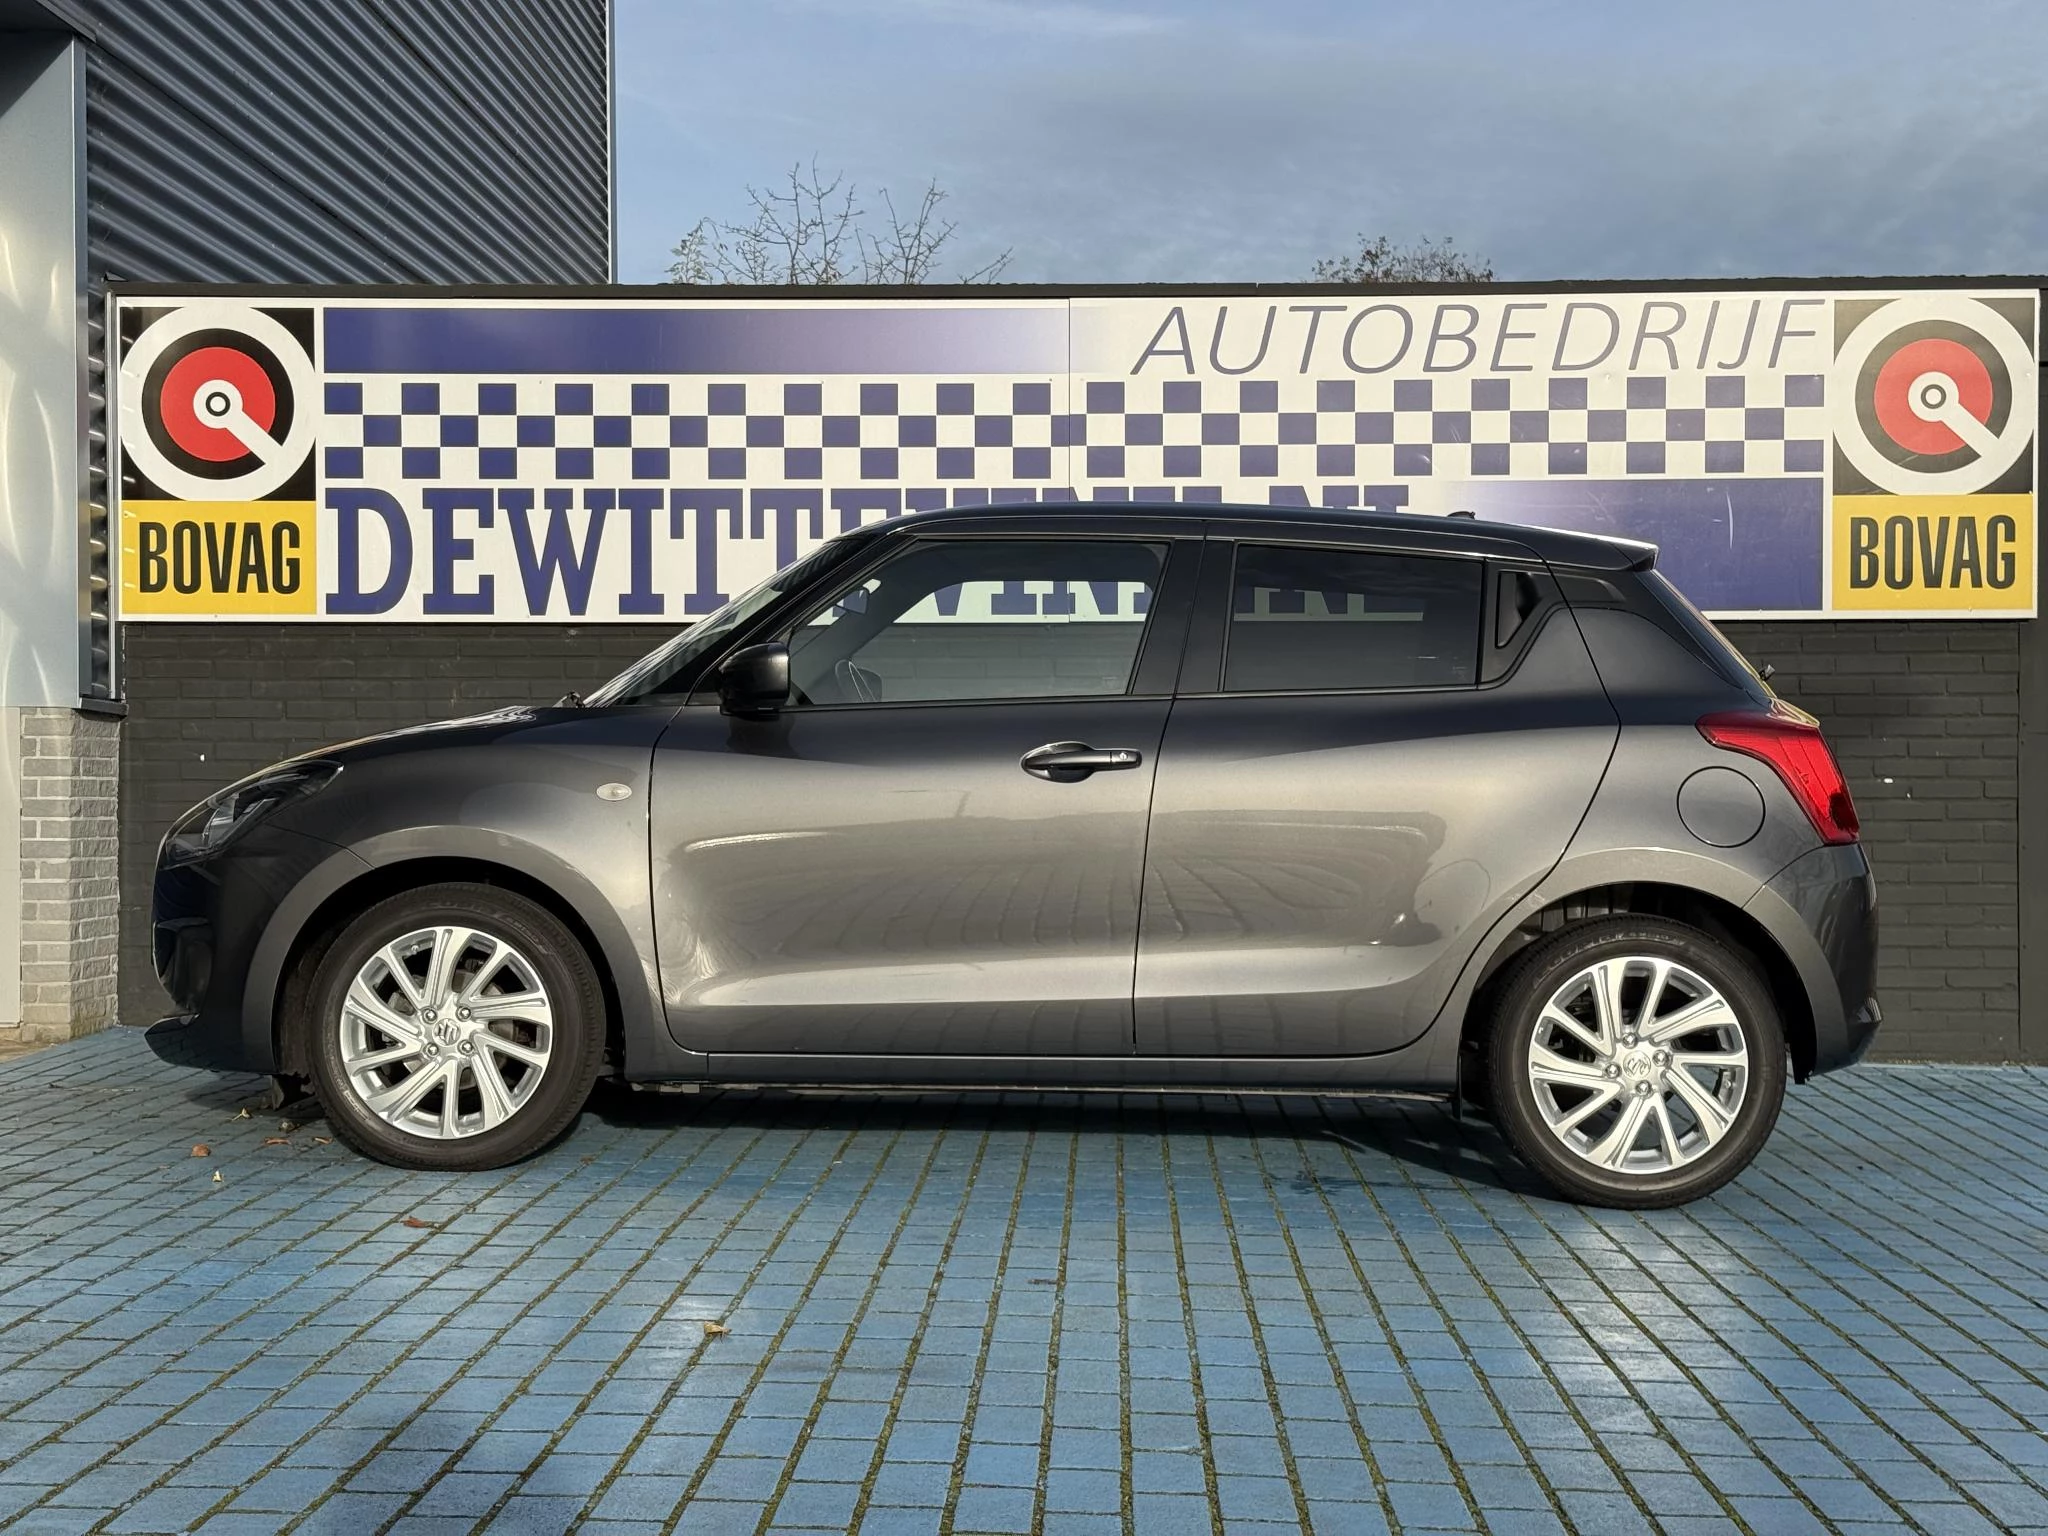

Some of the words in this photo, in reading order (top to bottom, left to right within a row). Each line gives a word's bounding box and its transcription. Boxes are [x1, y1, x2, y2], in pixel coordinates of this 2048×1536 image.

[1131, 299, 1827, 376] AUTOBEDRIJF
[138, 520, 300, 595] BOVAG
[1850, 514, 2016, 590] BOVAG
